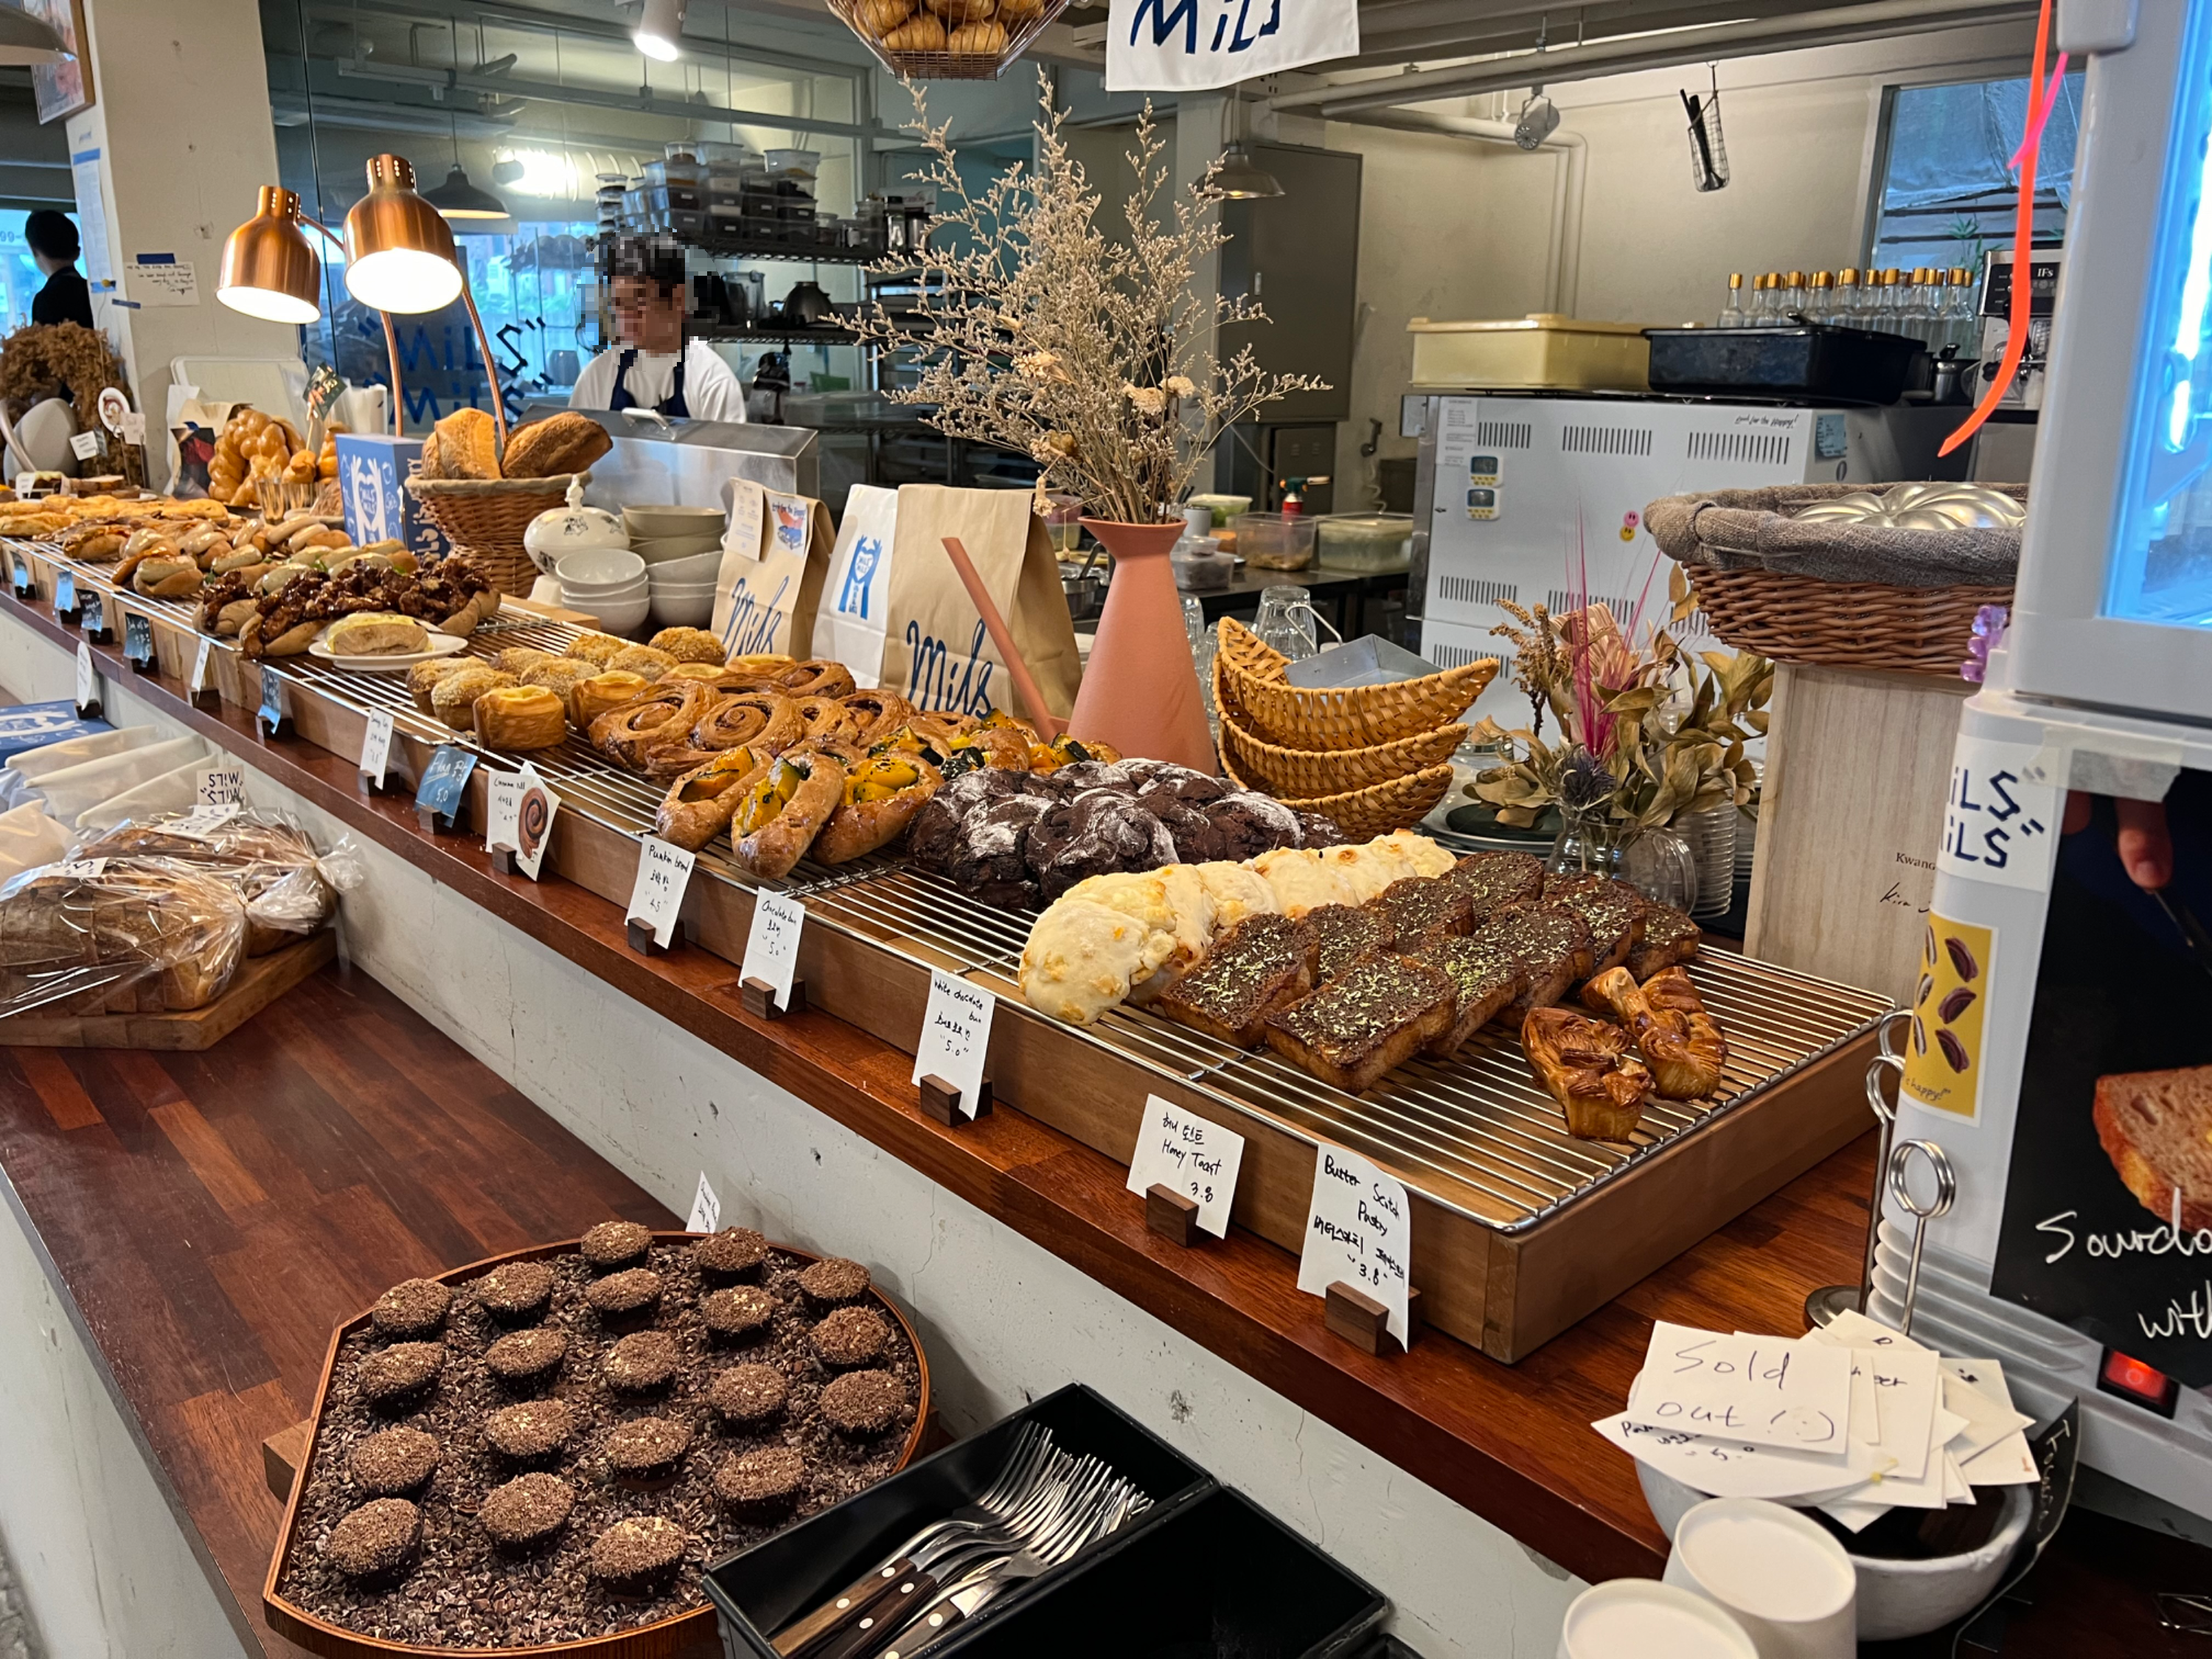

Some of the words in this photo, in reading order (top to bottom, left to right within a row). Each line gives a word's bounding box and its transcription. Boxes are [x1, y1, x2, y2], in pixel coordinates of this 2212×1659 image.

[1161, 1138, 1187, 1169] Honey
[1192, 1152, 1222, 1176] Toast
[1324, 1154, 1361, 1186] Butter
[1191, 1182, 1214, 1203] 3.8
[1674, 1340, 1790, 1390] Sold
[1657, 1402, 1745, 1427] out
